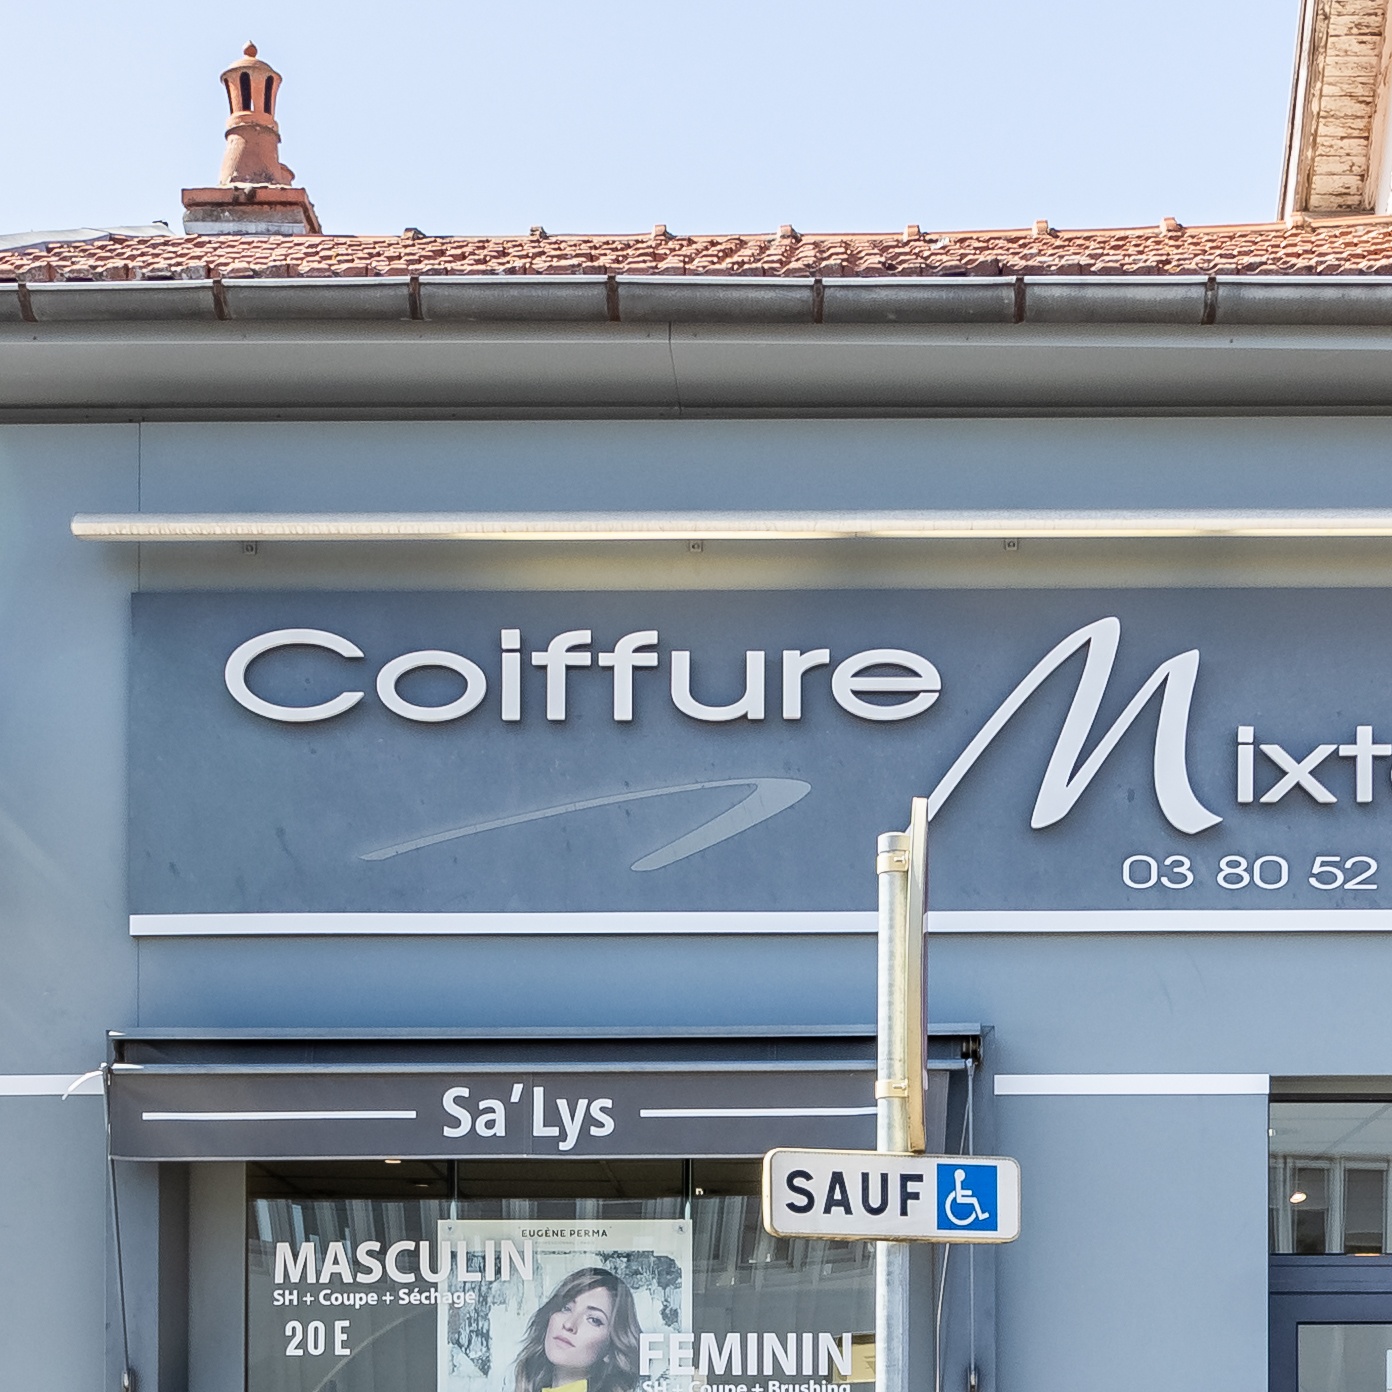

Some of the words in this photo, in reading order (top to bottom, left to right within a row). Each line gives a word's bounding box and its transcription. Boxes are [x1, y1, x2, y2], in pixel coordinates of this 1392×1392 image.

[224, 628, 942, 723] Coiffure
[1122, 856, 1194, 890] 03
[1216, 857, 1290, 890] 80
[1309, 858, 1378, 890] 52
[441, 1083, 616, 1151] Sa'Lys
[785, 1168, 925, 1217] SAUF
[521, 1226, 567, 1239] EUGÈNE
[569, 1228, 609, 1239] PERMA
[272, 1239, 535, 1285] MASCULIN
[272, 1289, 299, 1306] SH
[319, 1289, 378, 1309] Coupe
[398, 1287, 476, 1308] Séchage
[285, 1319, 326, 1356] 20
[334, 1319, 351, 1355] E
[639, 1332, 853, 1376] FEMININ
